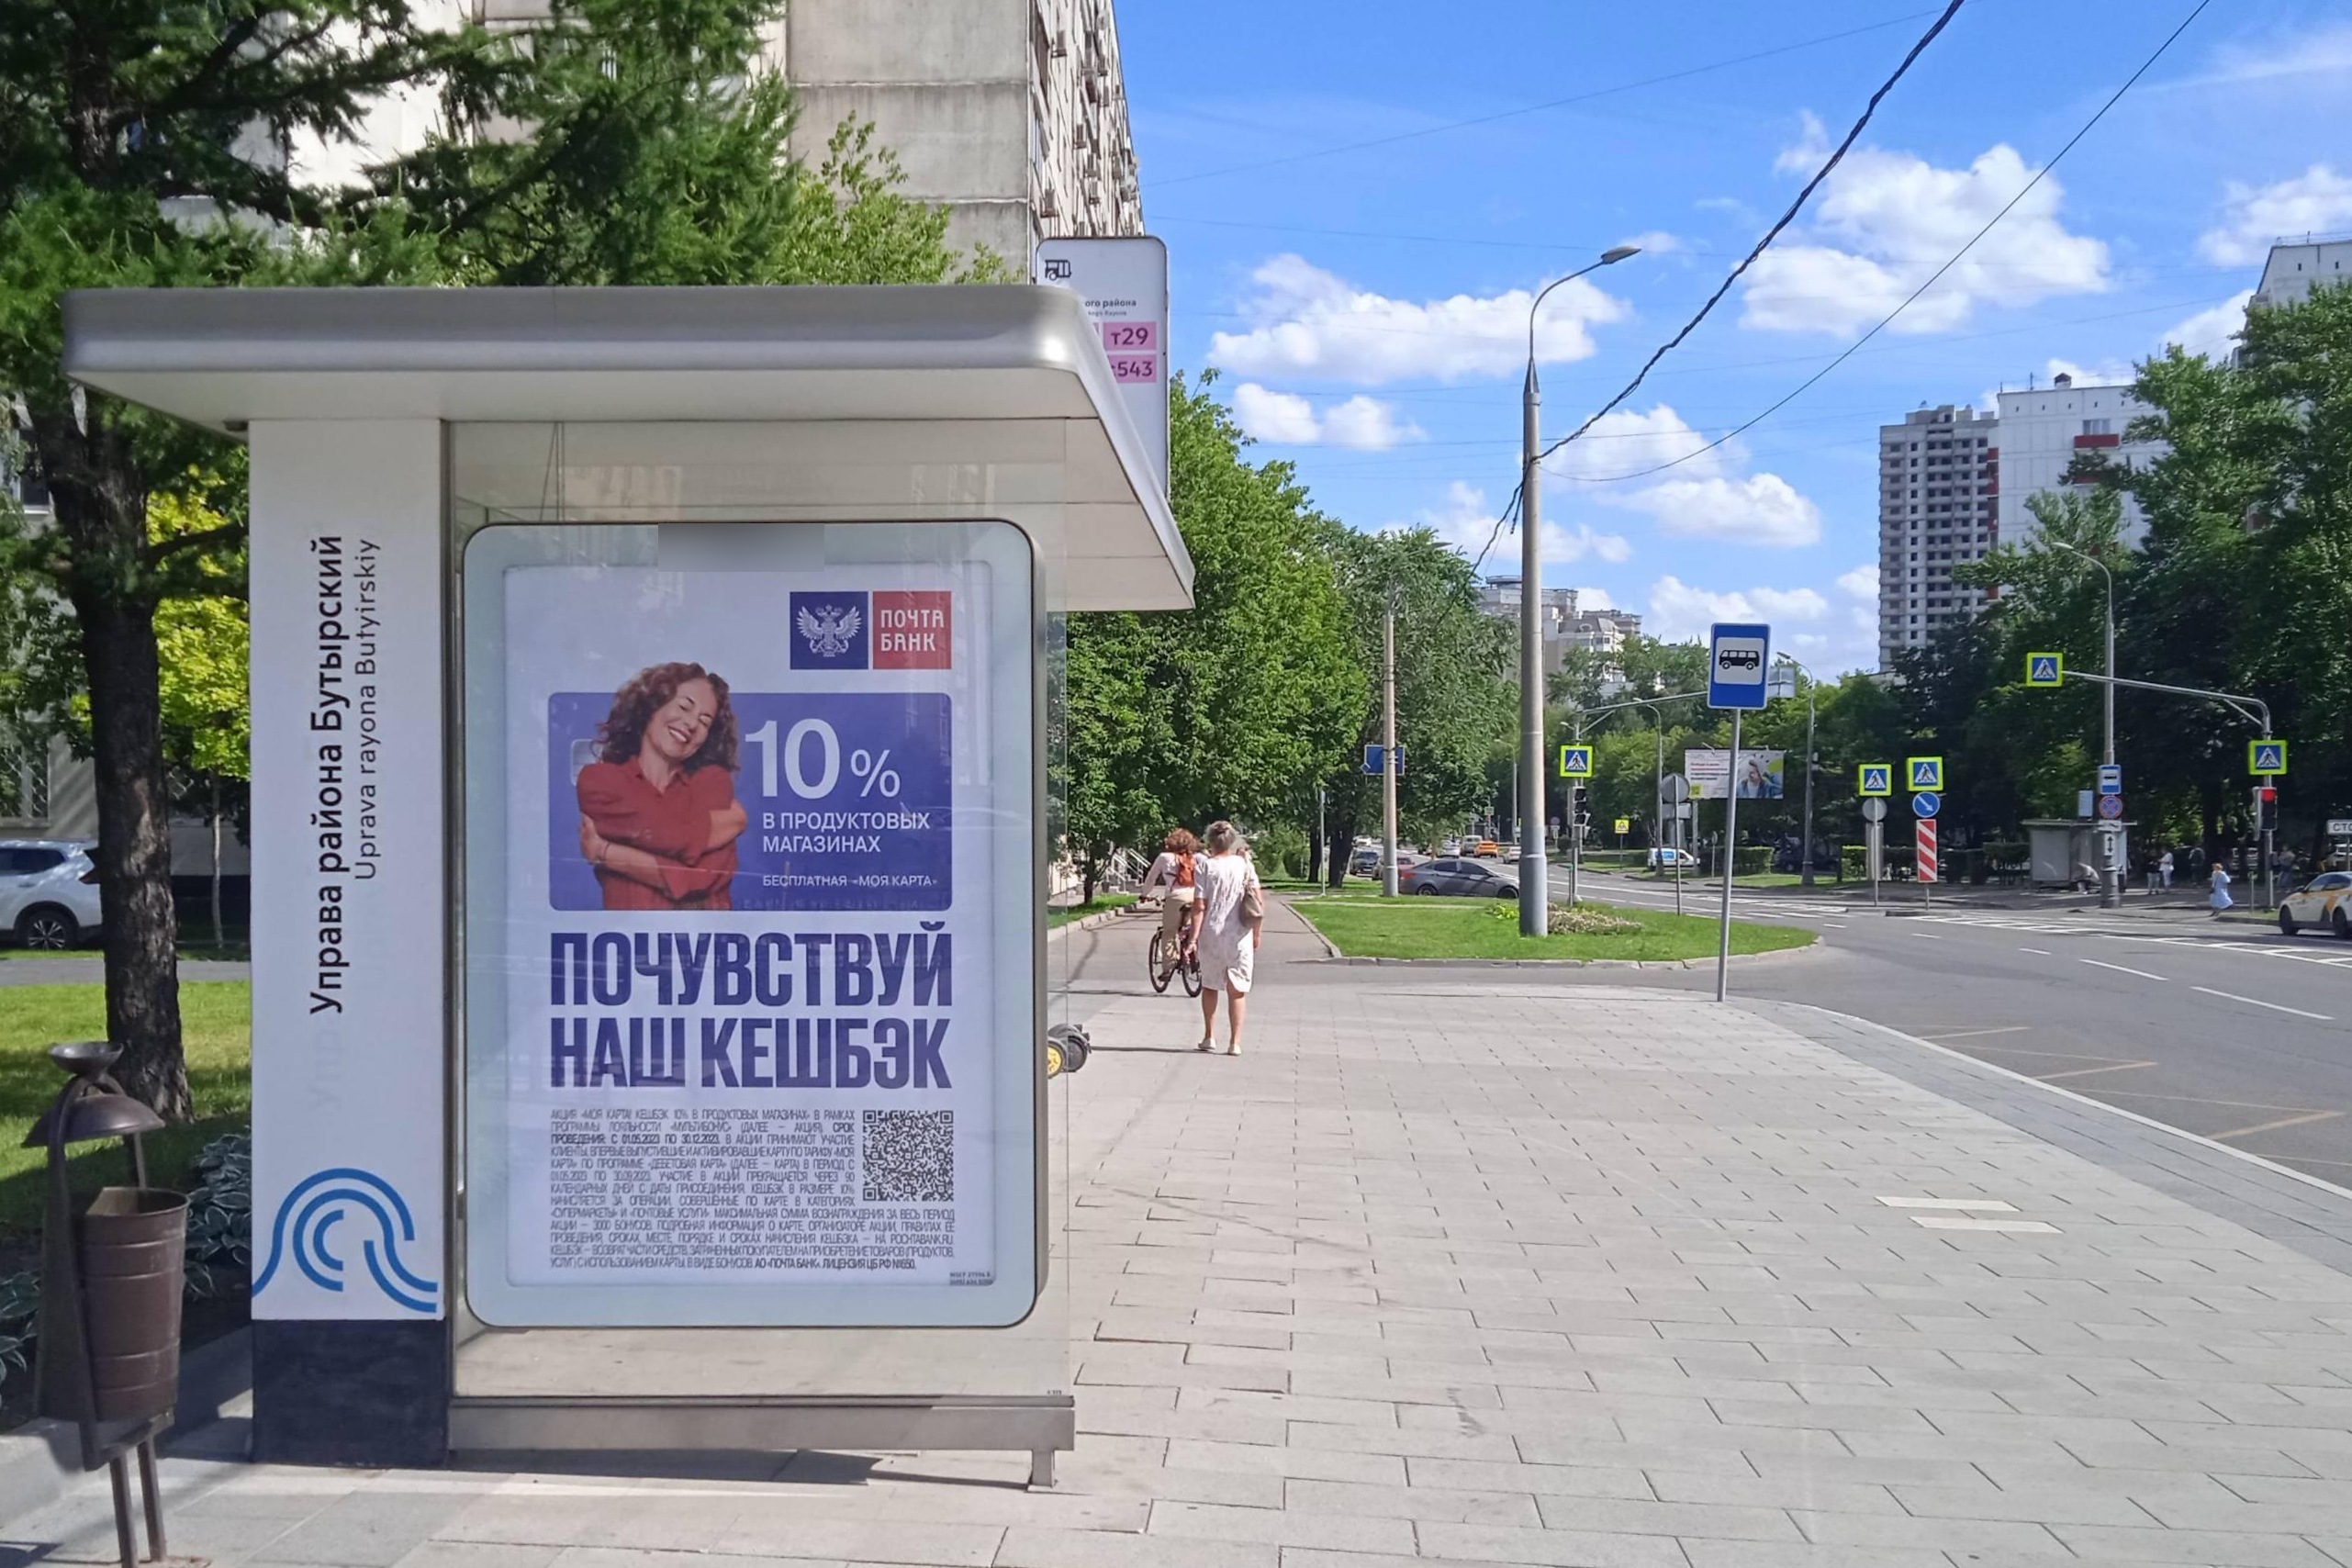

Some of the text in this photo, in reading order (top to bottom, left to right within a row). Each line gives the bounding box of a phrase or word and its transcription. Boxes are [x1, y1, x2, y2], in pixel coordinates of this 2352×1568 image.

[1085, 298, 1137, 308] ого района
[880, 609, 945, 629] ПОЧТА
[880, 633, 936, 652] БАНК
[354, 538, 381, 880] Uprava rayona Butyirskiy
[309, 535, 350, 1015] Управа района Бутырский
[763, 812, 930, 832] В ПРОДУКТОВЫХ
[762, 836, 881, 854] МАГАЗИНАХ
[762, 876, 937, 888] БЕСПЛАТНАЯ «МОЯ КАРТА»
[551, 920, 953, 1007] ПОЧУВСТВУЙ
[551, 1017, 952, 1090] НАШ КЕШБЭК
[551, 1109, 577, 1120] АКЦИЯ
[636, 1109, 668, 1120] КЕШБЭК
[675, 1109, 689, 1120] 10%
[692, 1109, 698, 1120] В
[702, 1109, 758, 1120] ПРОДУКТОВЫХ
[762, 1109, 810, 1120] МАГАЗИНАХ»
[814, 1109, 820, 1120] В
[824, 1109, 855, 1120] РАМКАХ
[551, 1121, 599, 1132] ПРОГРАММЫ
[610, 1121, 661, 1132] ЛОЯЛЬНОСТИ
[833, 1122, 855, 1133] СРОК
[611, 1134, 618, 1145] С
[665, 1134, 677, 1145] ПО
[725, 1134, 732, 1145] В
[736, 1134, 762, 1145] АКЦИИ
[767, 1134, 816, 1145] ПРИНИМАЮТ
[822, 1134, 855, 1145] УЧАСТИЕ
[767, 1146, 790, 1157] КАРТУ
[790, 1146, 802, 1157] ПО
[804, 1146, 833, 1157] ТАРИФУ
[582, 1159, 593, 1170] ПО
[598, 1159, 644, 1170] ПРОГРАММЕ
[700, 1159, 726, 1170] КАРТА»
[803, 1159, 810, 1170] В
[813, 1159, 845, 1170] ПЕРИОД
[848, 1159, 855, 1170] С
[595, 1170, 606, 1182] ПО
[660, 1170, 693, 1182] УЧАСТИЕ
[700, 1170, 706, 1182] В
[713, 1170, 739, 1182] АКЦИИ
[747, 1170, 808, 1182] ПРЕКРАЩАЕТСЯ
[814, 1170, 838, 1182] ЧЕРЕЗ
[846, 1170, 855, 1182] 90
[551, 1183, 607, 1194] КАЛЕНДАРНЫХ
[613, 1183, 633, 1194] ДНЕЙ
[639, 1183, 645, 1194] С
[651, 1183, 671, 1194] ДАТЫ
[752, 1183, 783, 1194] КЕШБЭК
[789, 1183, 794, 1194] В
[801, 1183, 834, 1194] РАЗМЕРЕ
[841, 1183, 855, 1194] 10%
[613, 1195, 622, 1206] ЗА
[679, 1195, 738, 1206] СОВЕРШЕННЫЕ
[746, 1195, 757, 1206] ПО
[764, 1195, 788, 1206] КАРТЕ
[795, 1195, 801, 1206] В
[807, 1195, 855, 1206] КАТЕГОРИЯХ
[621, 1207, 627, 1218] И
[714, 1208, 778, 1219] МАКСИМАЛЬНАЯ
[781, 1208, 809, 1219] СУММА
[812, 1208, 884, 1219] ВОЗНАГРАЖДЕНИЯ
[887, 1208, 897, 1220] ЗА
[901, 1208, 920, 1220] ВЕСЬ
[924, 1208, 955, 1220] ПЕРИОД
[551, 1220, 577, 1231] АКЦИИ
[657, 1220, 705, 1231] ПОДРОБНАЯ
[709, 1220, 764, 1231] ИНФОРМАЦИЯ
[768, 1220, 775, 1231] О
[809, 1221, 866, 1232] ОРГАНИЗАТОРЕ
[902, 1221, 942, 1232] ПРАВИЛАХ
[946, 1221, 955, 1232] ЕЕ
[678, 1233, 714, 1244] ПОРЯДКЕ
[720, 1233, 725, 1244] И
[730, 1233, 760, 1244] СРОКАХ
[766, 1233, 815, 1244] НАЧИСЛЕНИЯ
[821, 1233, 858, 1244] КЕШБЭКА
[875, 1234, 886, 1244] НА
[592, 1245, 625, 1256] ВОЗВРАТ
[799, 1245, 809, 1257] НА
[871, 1246, 904, 1257] ТОВАРОВ
[694, 1258, 715, 1269] ВИДЕ
[756, 1258, 767, 1269] АО
[767, 1258, 796, 1269] «ПОЧТА
[823, 1258, 866, 1270] ЛИЦЕНЗИЯ
[868, 1259, 879, 1270] ЦБ
[879, 1259, 890, 1270] РФ
